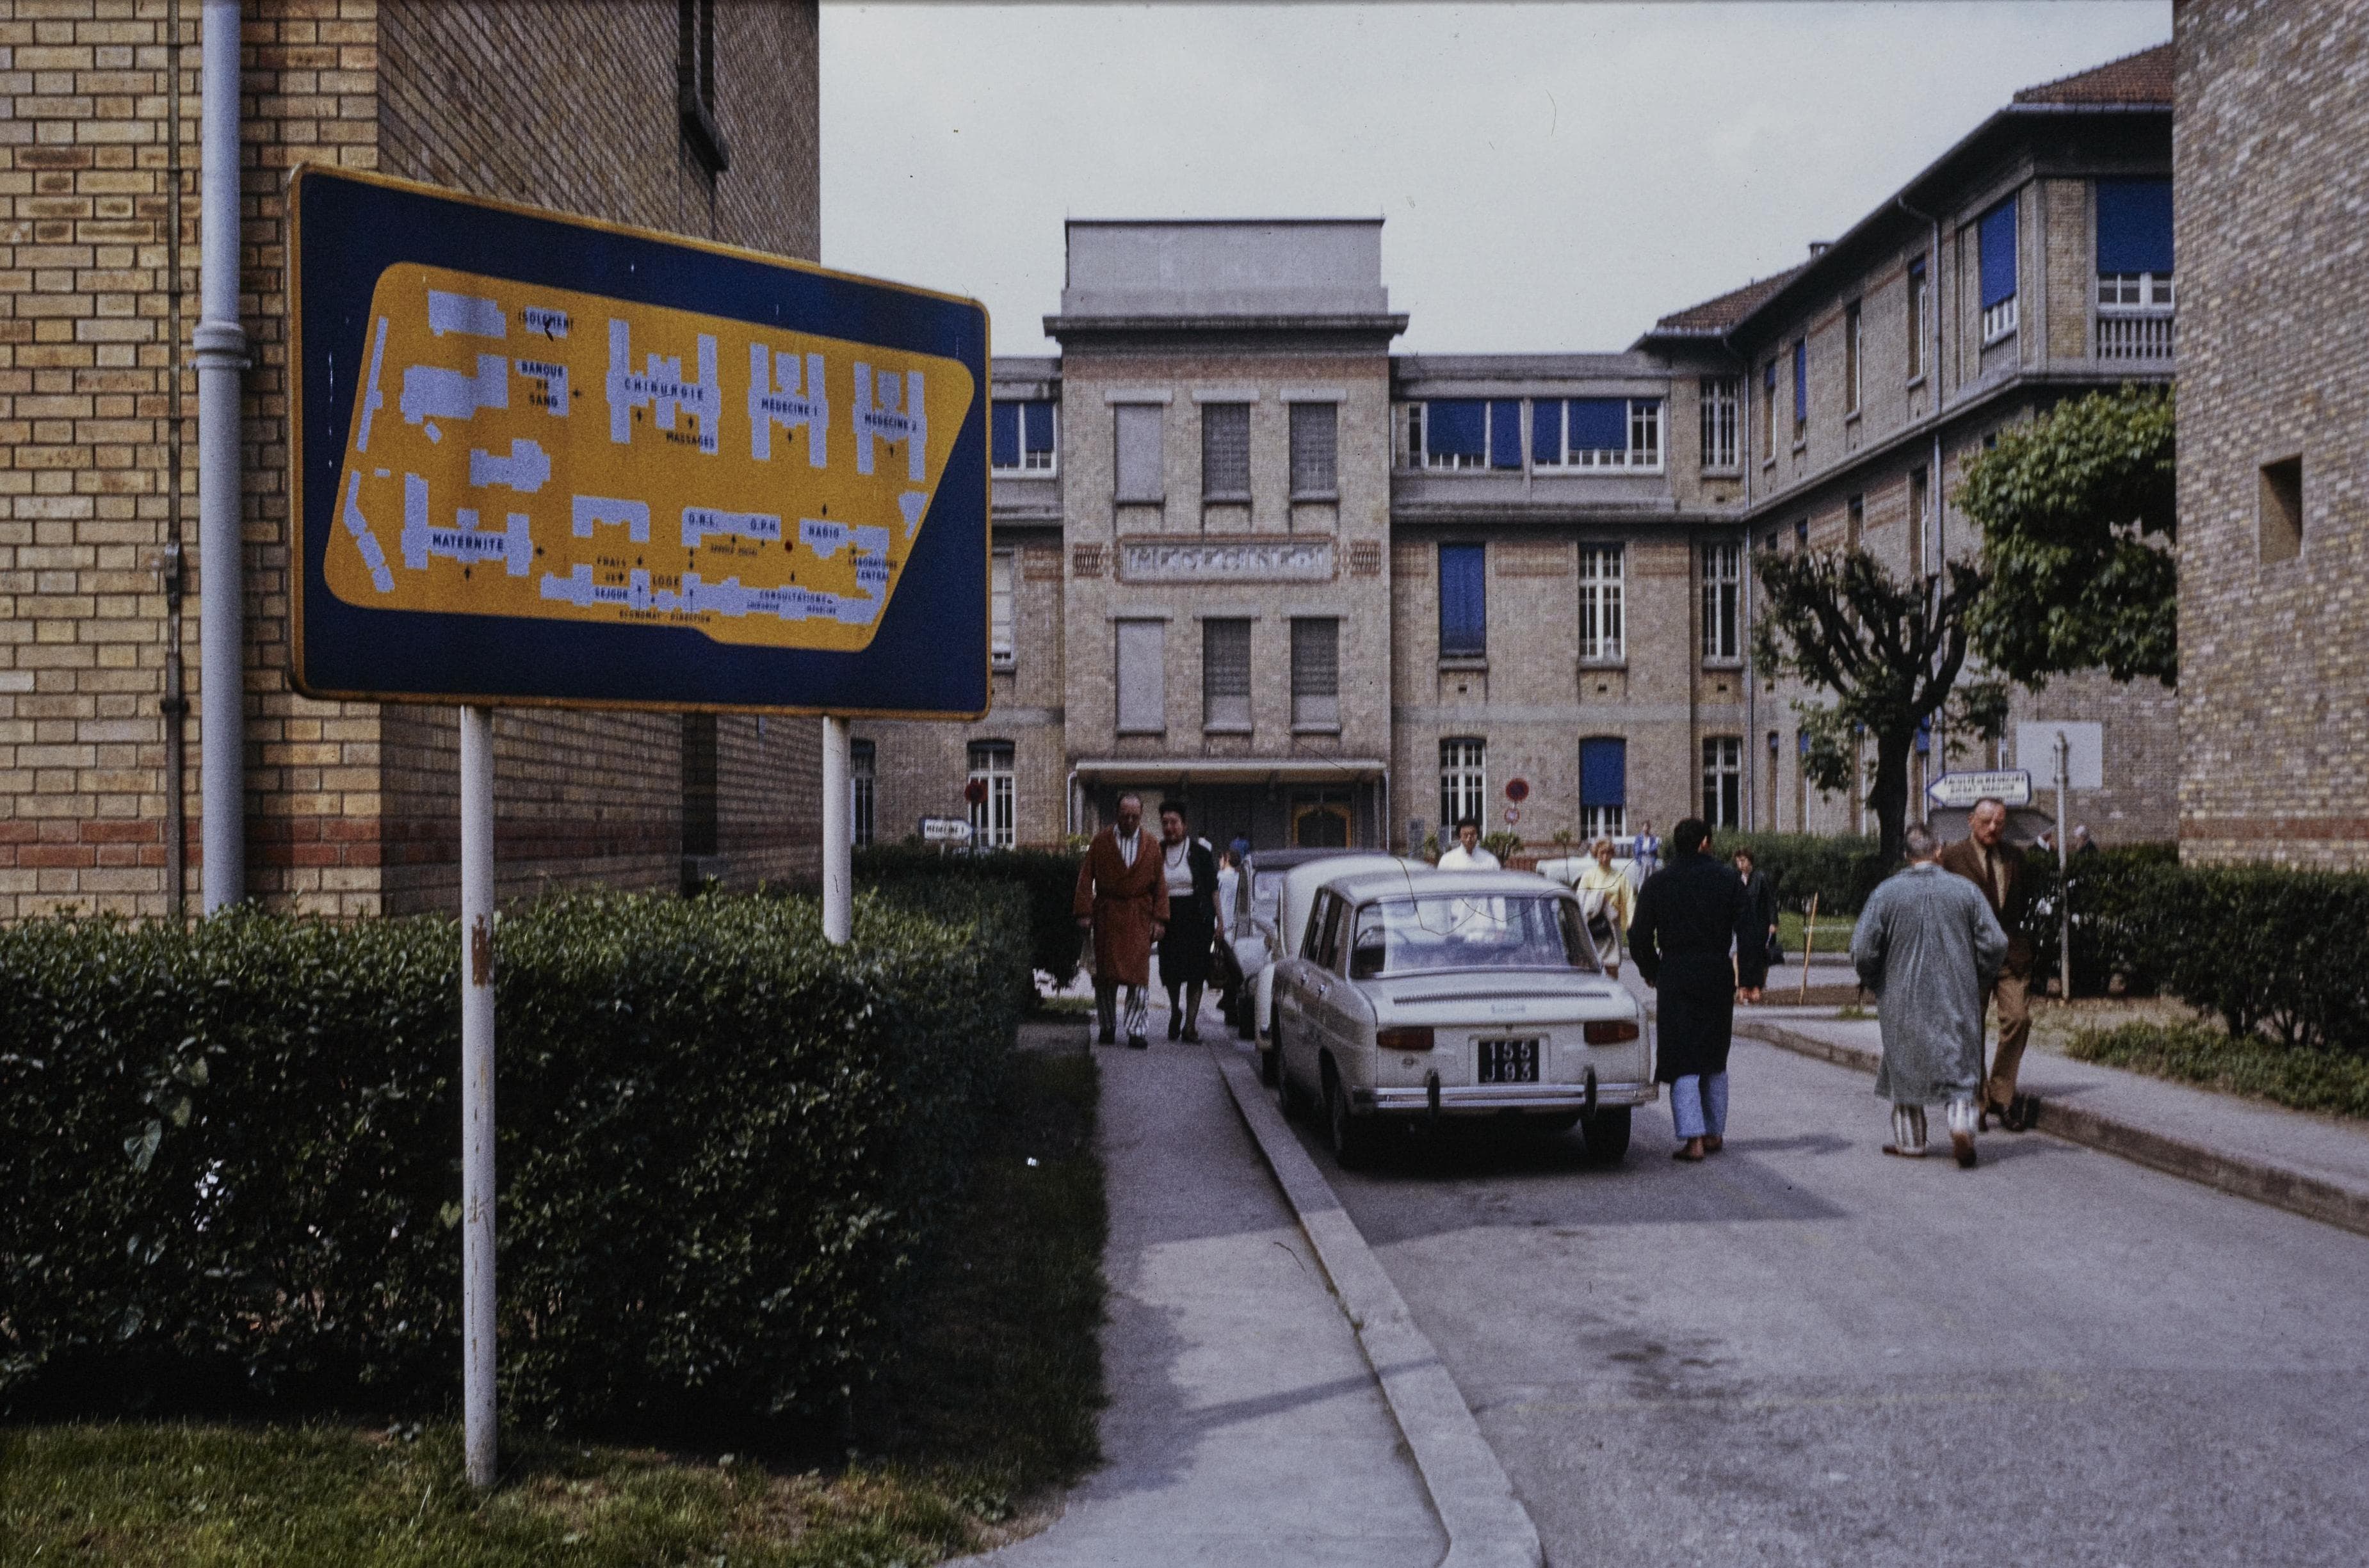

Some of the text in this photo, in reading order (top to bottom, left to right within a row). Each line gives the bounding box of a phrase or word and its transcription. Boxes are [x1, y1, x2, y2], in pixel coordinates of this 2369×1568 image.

[521, 360, 564, 378] BANQUE
[624, 377, 704, 401] CHIRURGIE
[666, 432, 715, 449] MASSAGES
[809, 525, 839, 540] RADIO
[597, 556, 626, 567] FRAIS
[848, 556, 897, 570] LABORATOIRE
[759, 590, 826, 603] CONSULTATIONS
[670, 611, 711, 623] DIRECTION
